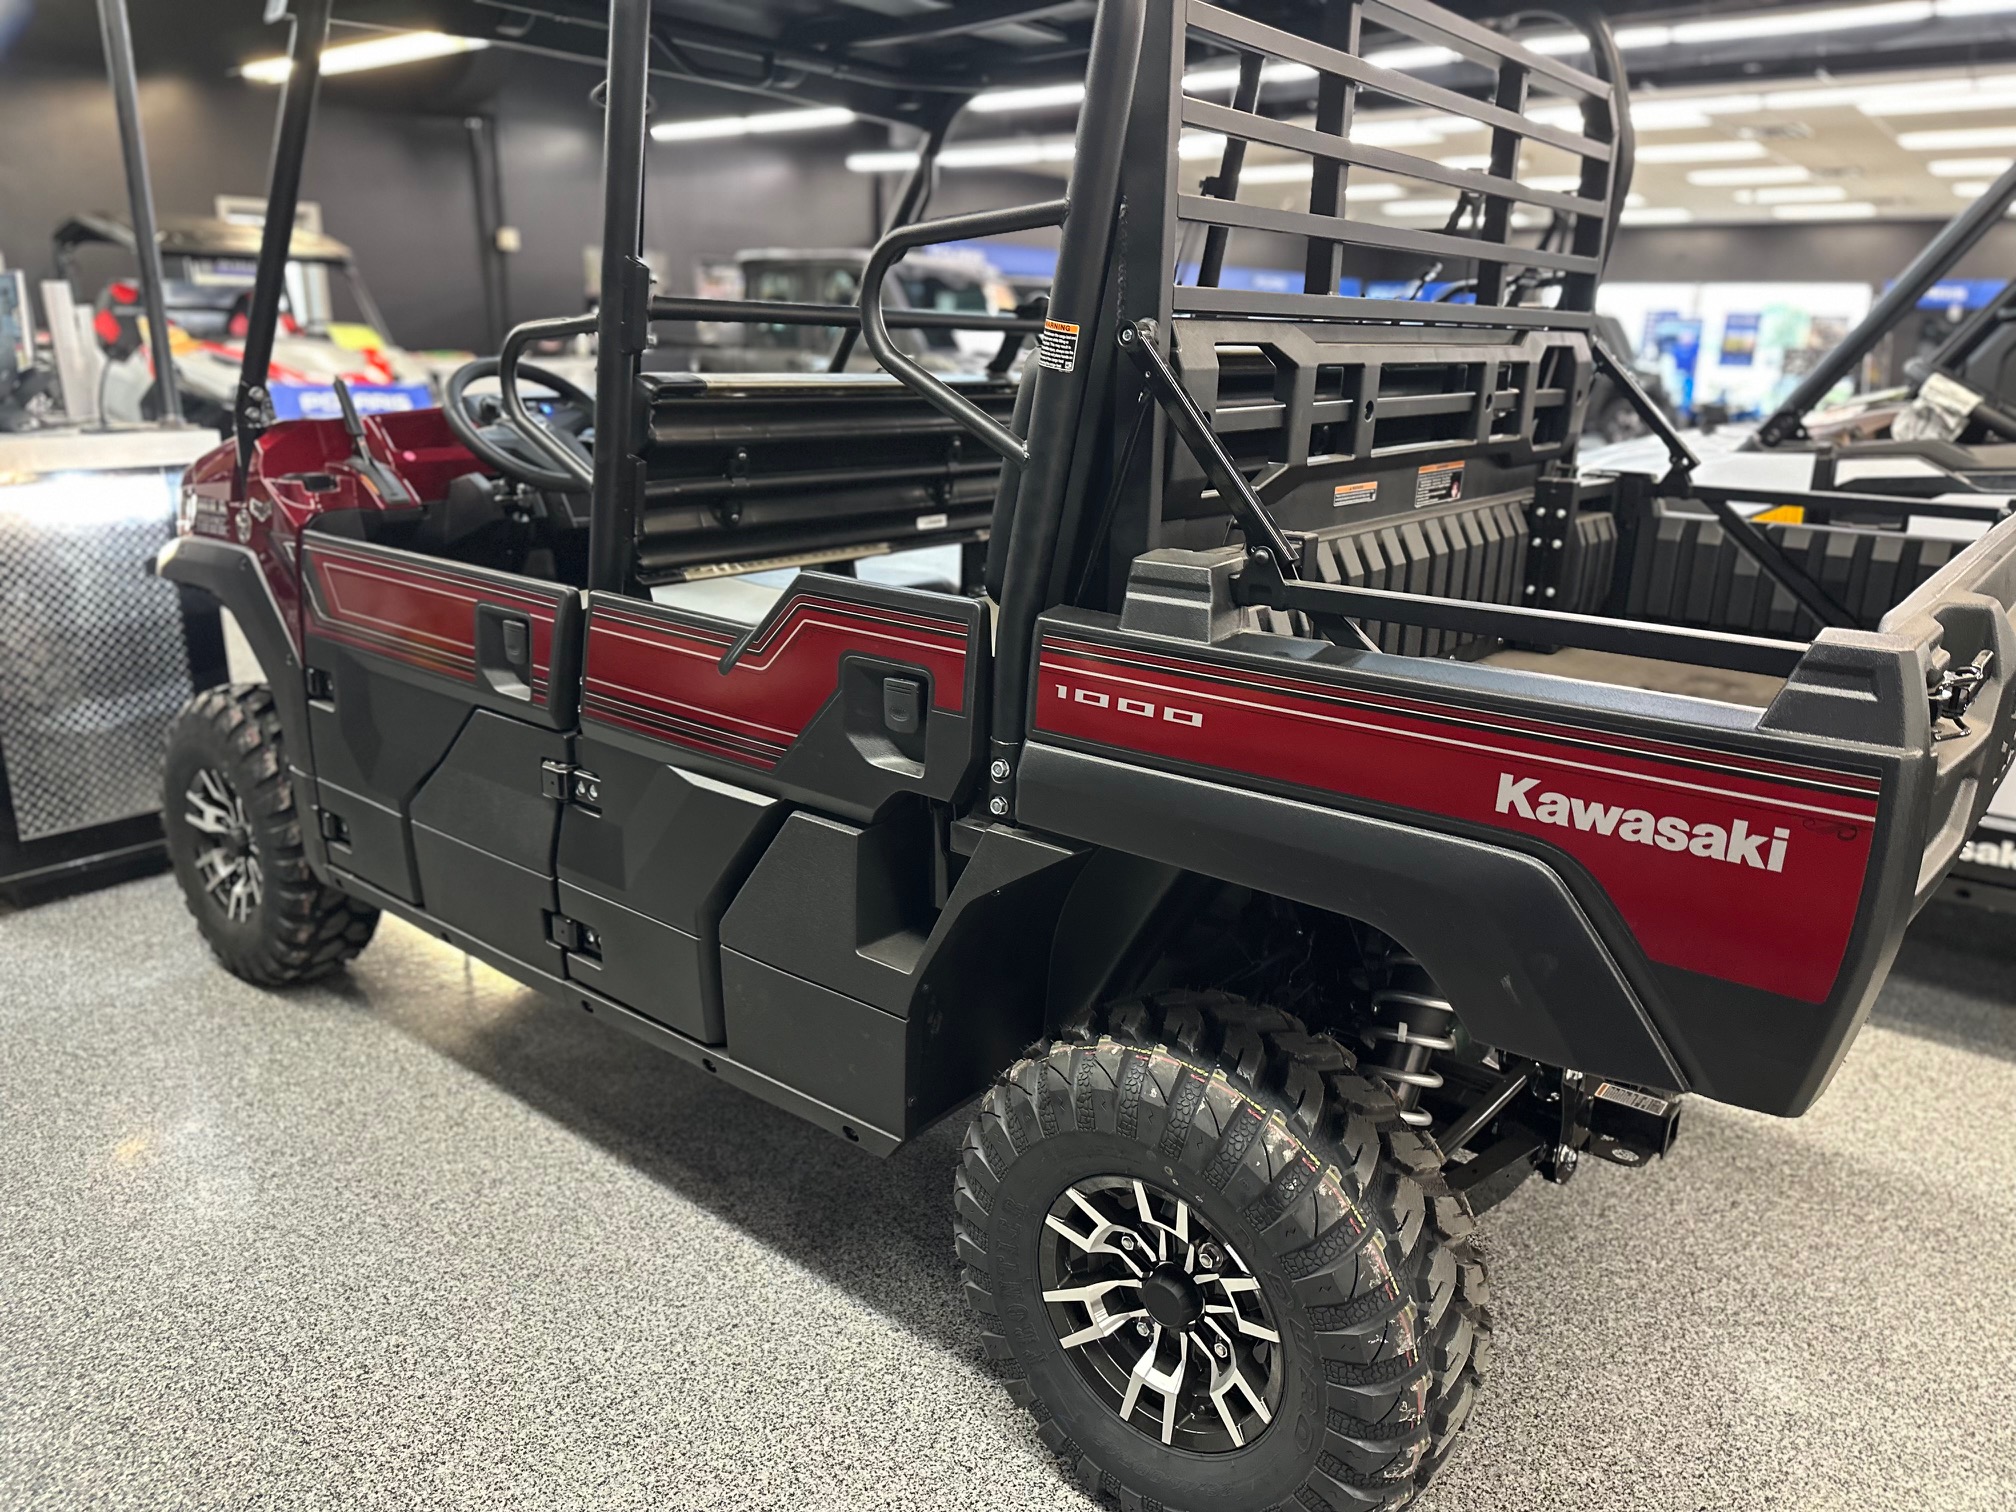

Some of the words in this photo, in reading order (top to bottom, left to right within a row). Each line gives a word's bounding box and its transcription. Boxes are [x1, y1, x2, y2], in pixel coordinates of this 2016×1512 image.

[298, 391, 413, 414] POARIS
[1055, 684, 1203, 728] 1000
[1495, 772, 1790, 873] Kawasaki
[996, 1197, 1049, 1366] FRONTIER
[1262, 1269, 1318, 1454] DURO
